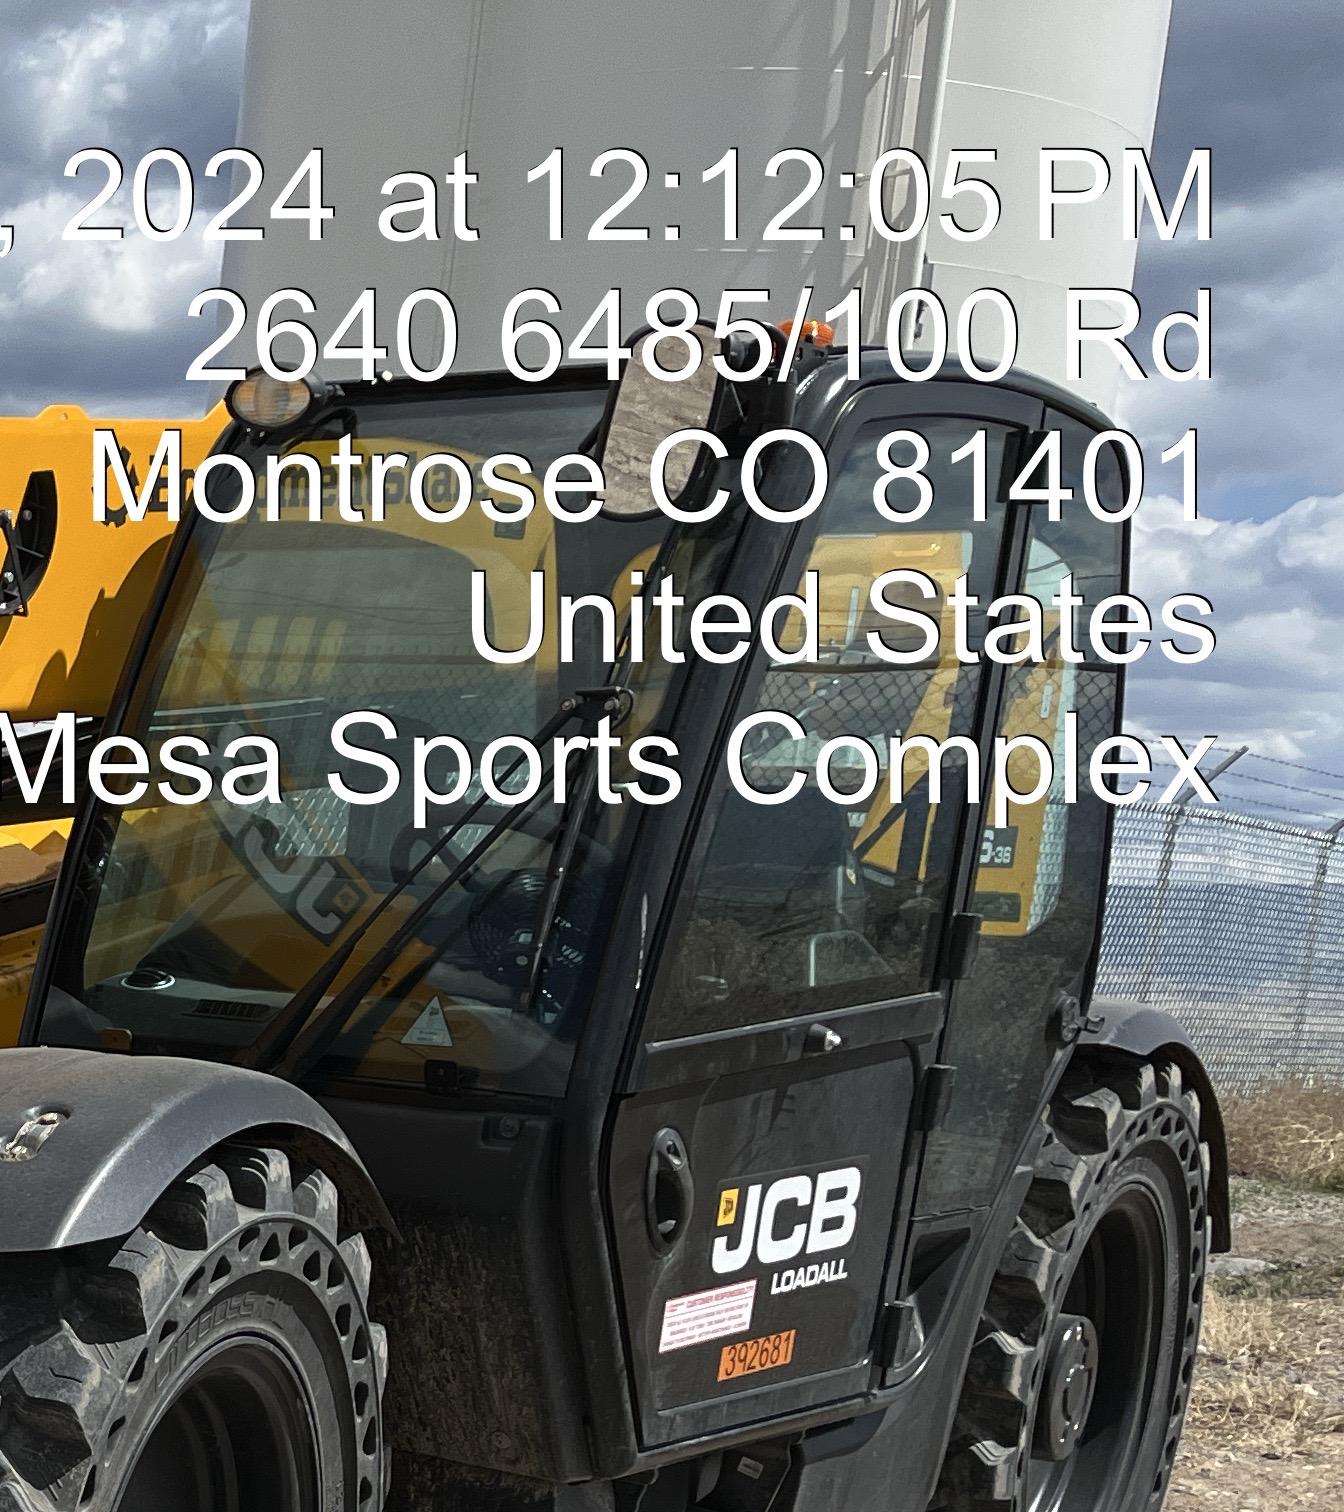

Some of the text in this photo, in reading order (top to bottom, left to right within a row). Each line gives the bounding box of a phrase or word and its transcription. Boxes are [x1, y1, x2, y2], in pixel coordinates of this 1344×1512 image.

[712, 1167, 861, 1273] JCB
[770, 1258, 848, 1295] LOADALL
[725, 1333, 791, 1377] 392681
